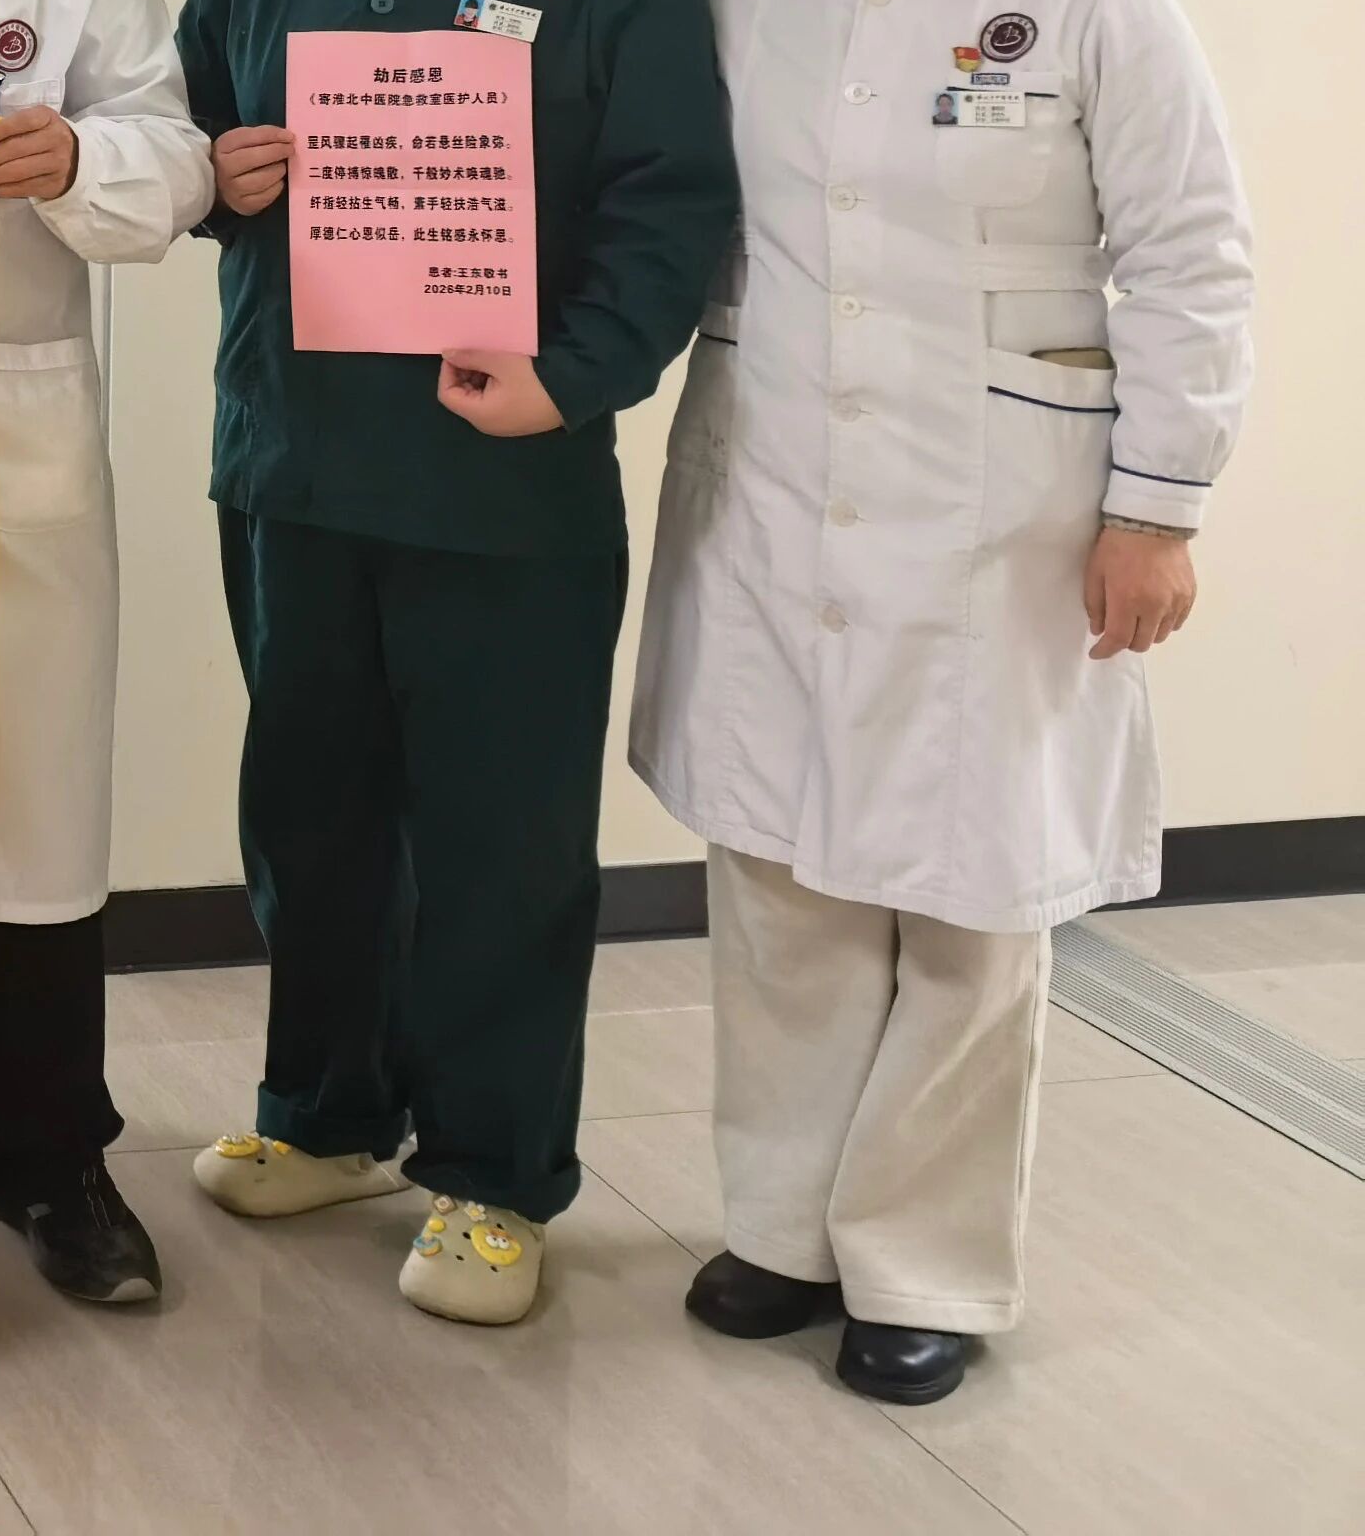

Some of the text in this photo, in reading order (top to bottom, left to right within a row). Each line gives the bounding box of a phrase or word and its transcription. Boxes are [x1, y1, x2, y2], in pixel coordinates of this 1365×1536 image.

[373, 66, 443, 83] 劫后感恩
[309, 91, 508, 107] 《寄淮北中医院急救室医护人员》
[424, 284, 512, 296] 2026年2月10日
